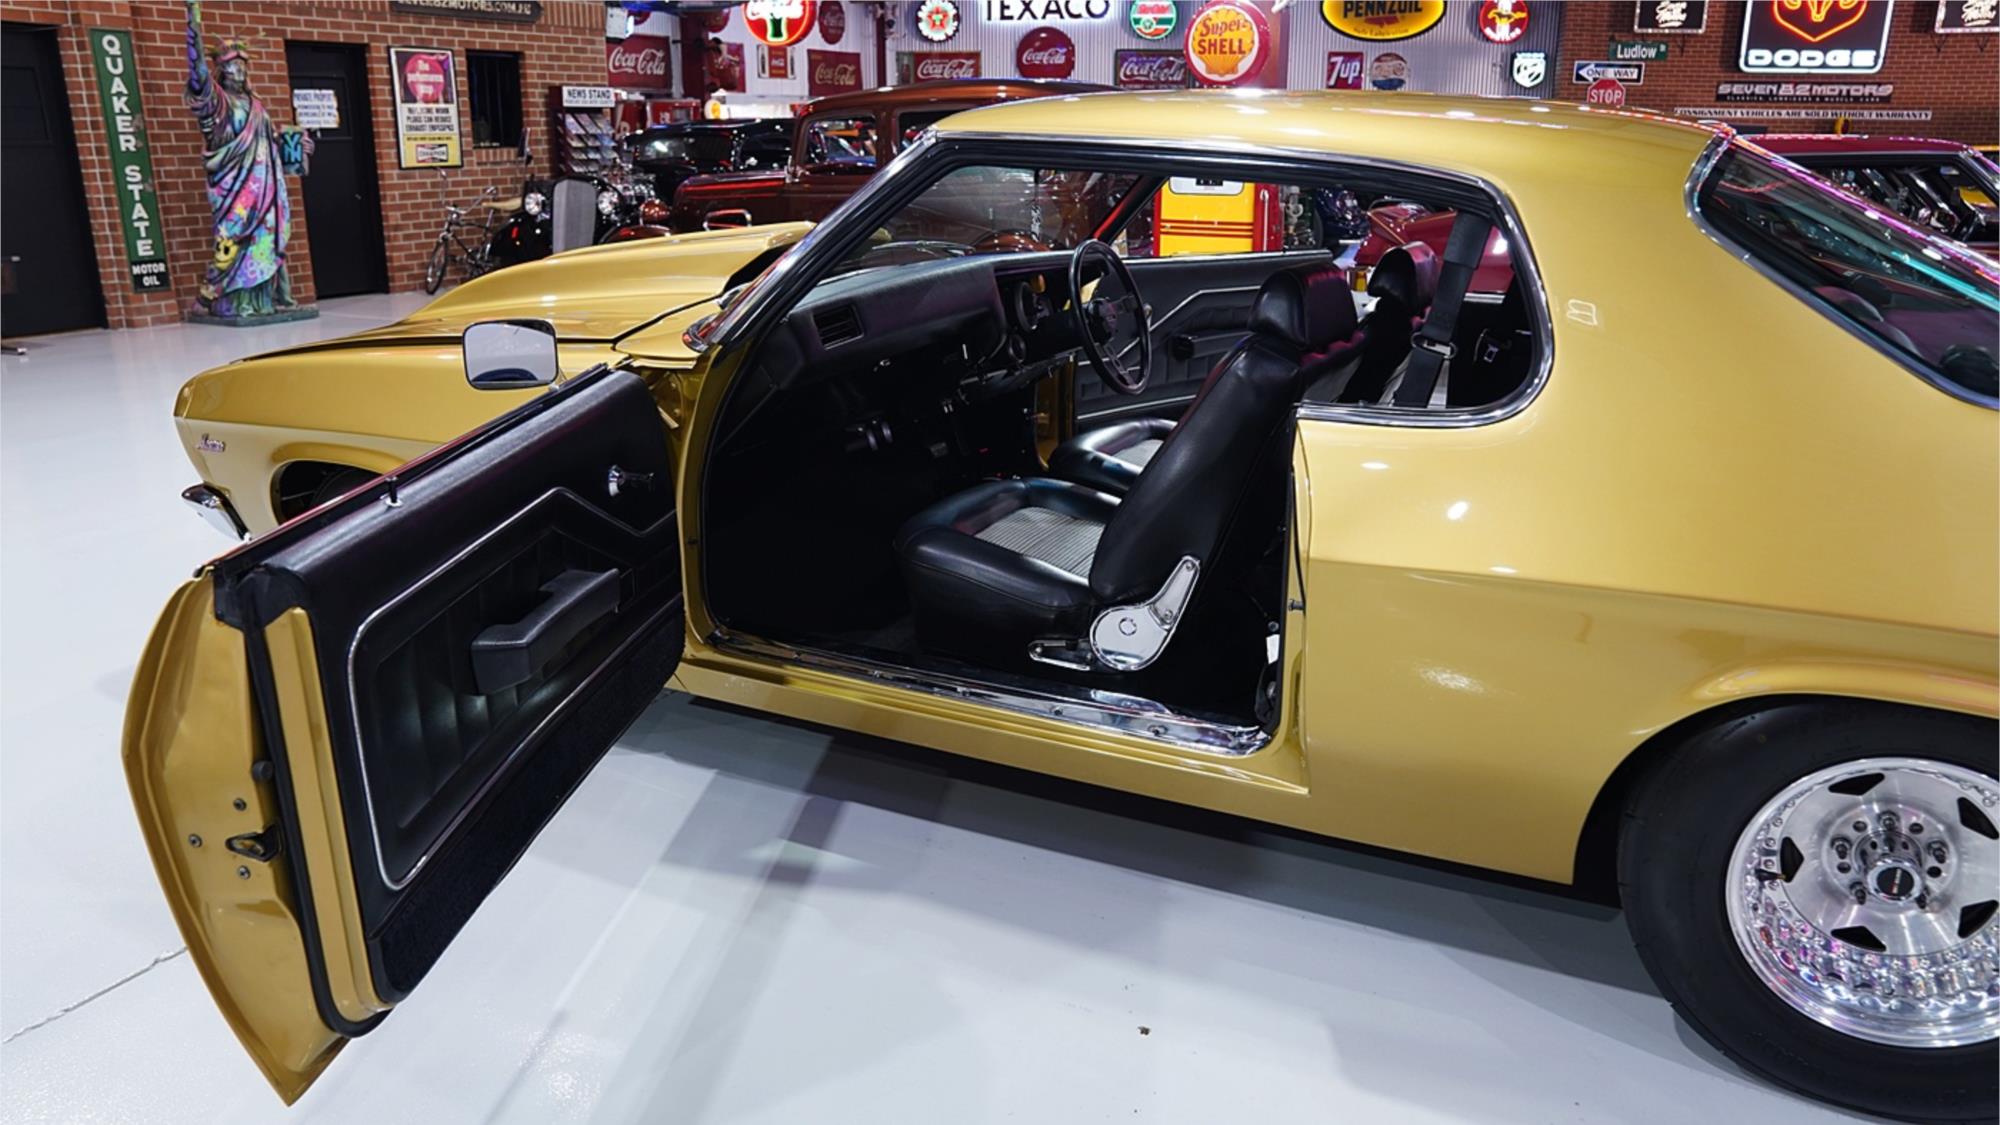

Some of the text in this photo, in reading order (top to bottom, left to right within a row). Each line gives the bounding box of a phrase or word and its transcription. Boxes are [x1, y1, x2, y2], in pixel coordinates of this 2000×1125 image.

[1197, 38, 1246, 55] SHELL
[1616, 44, 1657, 58] Ludlow
[1748, 49, 1877, 67] DODGE
[1613, 68, 1637, 77] WAY
[567, 88, 611, 100] NEWS STAND
[1589, 89, 1622, 103] STOP
[102, 34, 155, 257] QUAKER STATE
[132, 262, 166, 275] MOTOR
[142, 275, 160, 286] OIL
